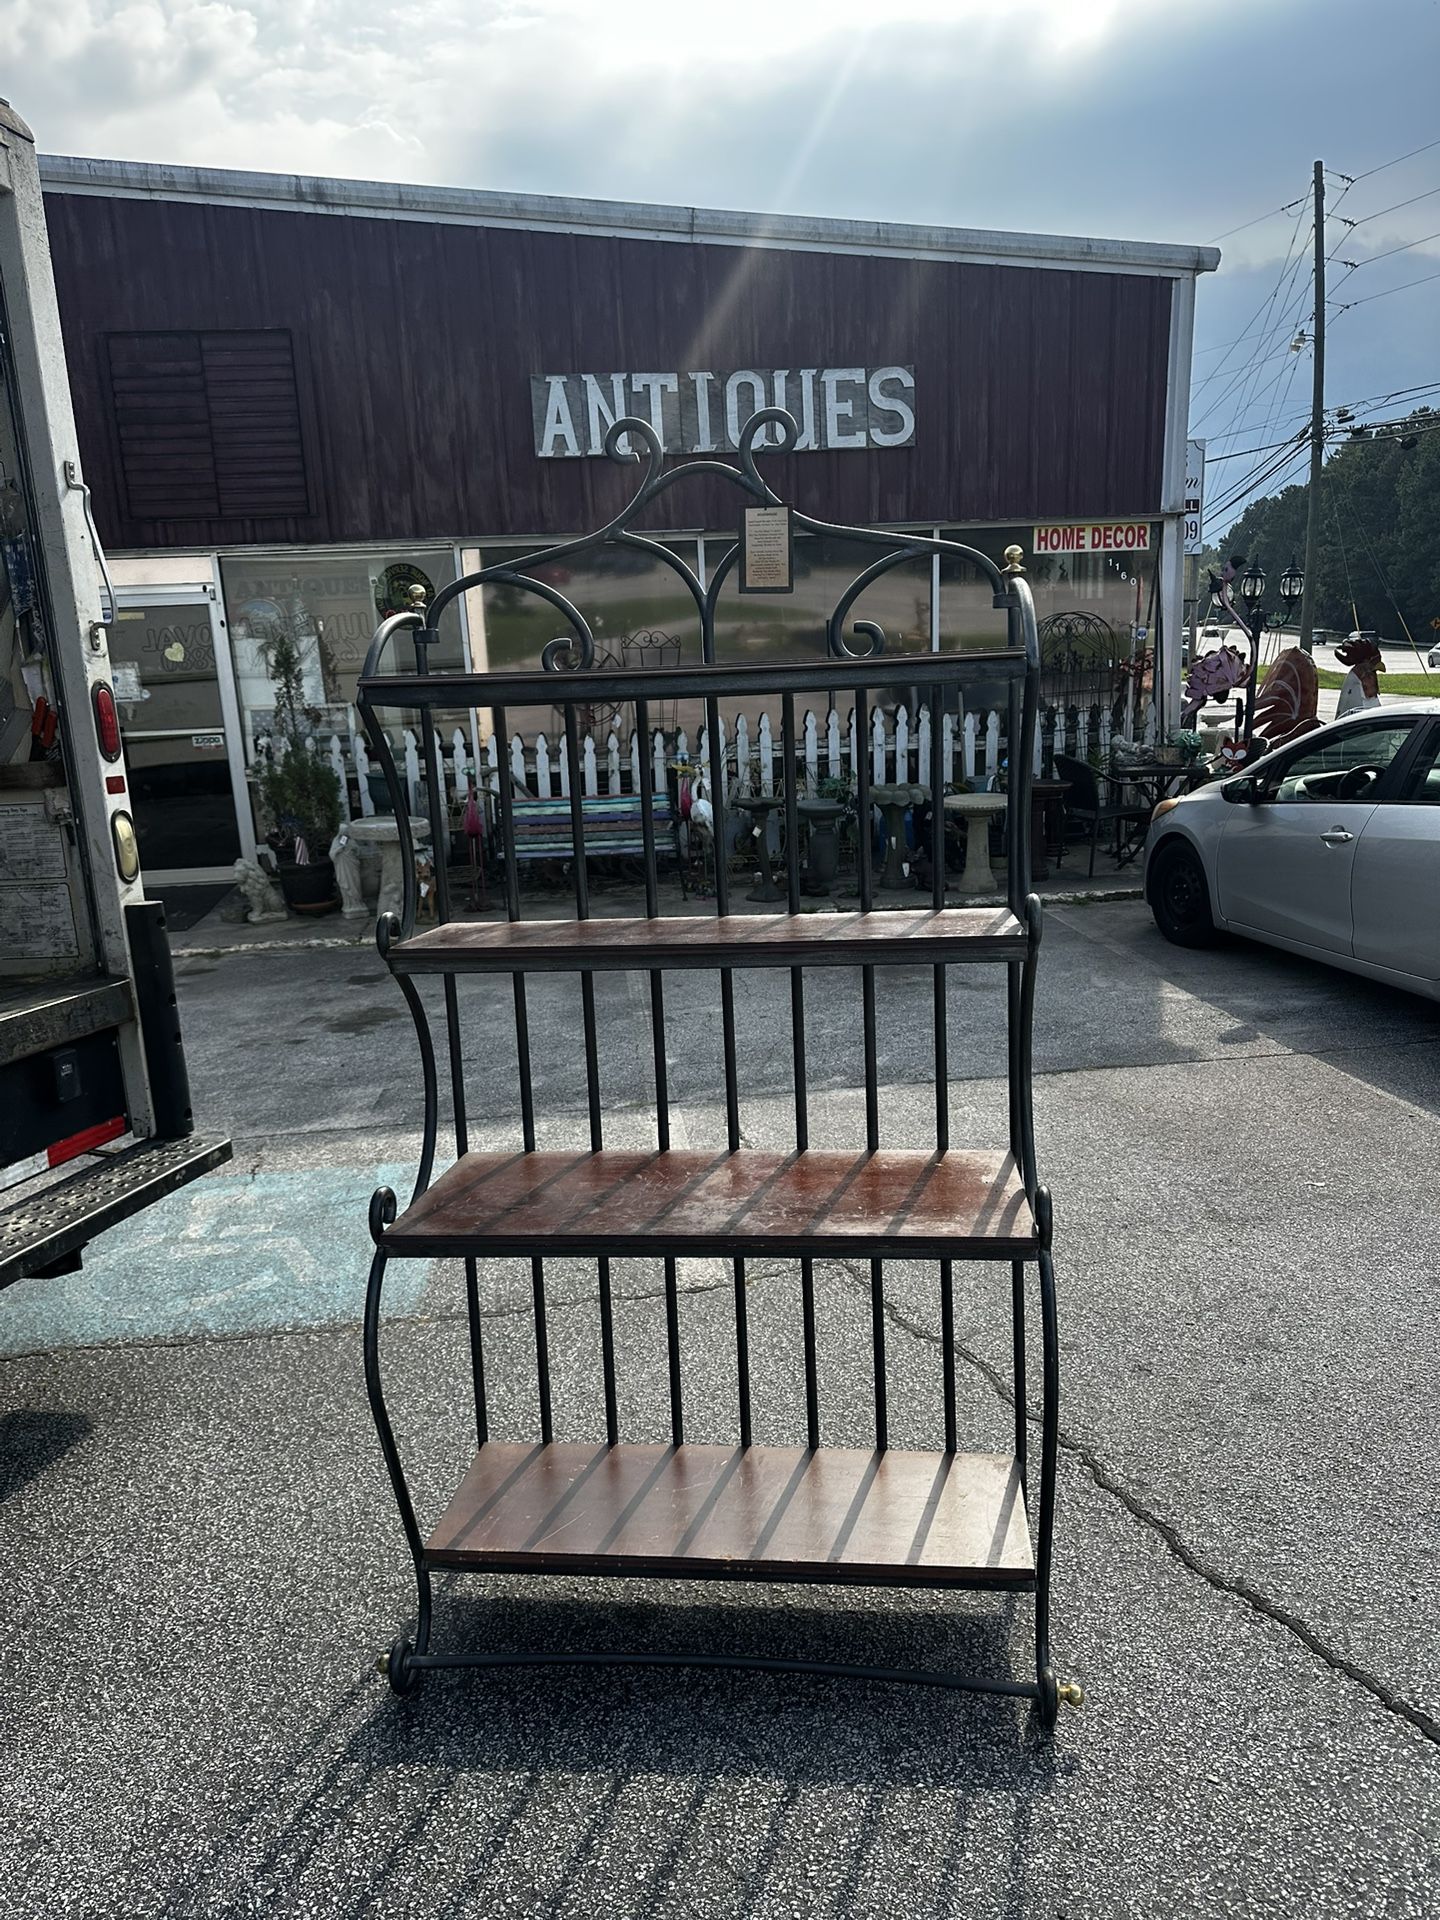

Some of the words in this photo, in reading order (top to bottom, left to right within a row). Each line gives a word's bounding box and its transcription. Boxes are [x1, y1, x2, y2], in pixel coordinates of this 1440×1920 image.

[538, 366, 915, 457] ANTIQUES
[1037, 527, 1086, 551] HOME
[1091, 525, 1148, 549] DECOR
